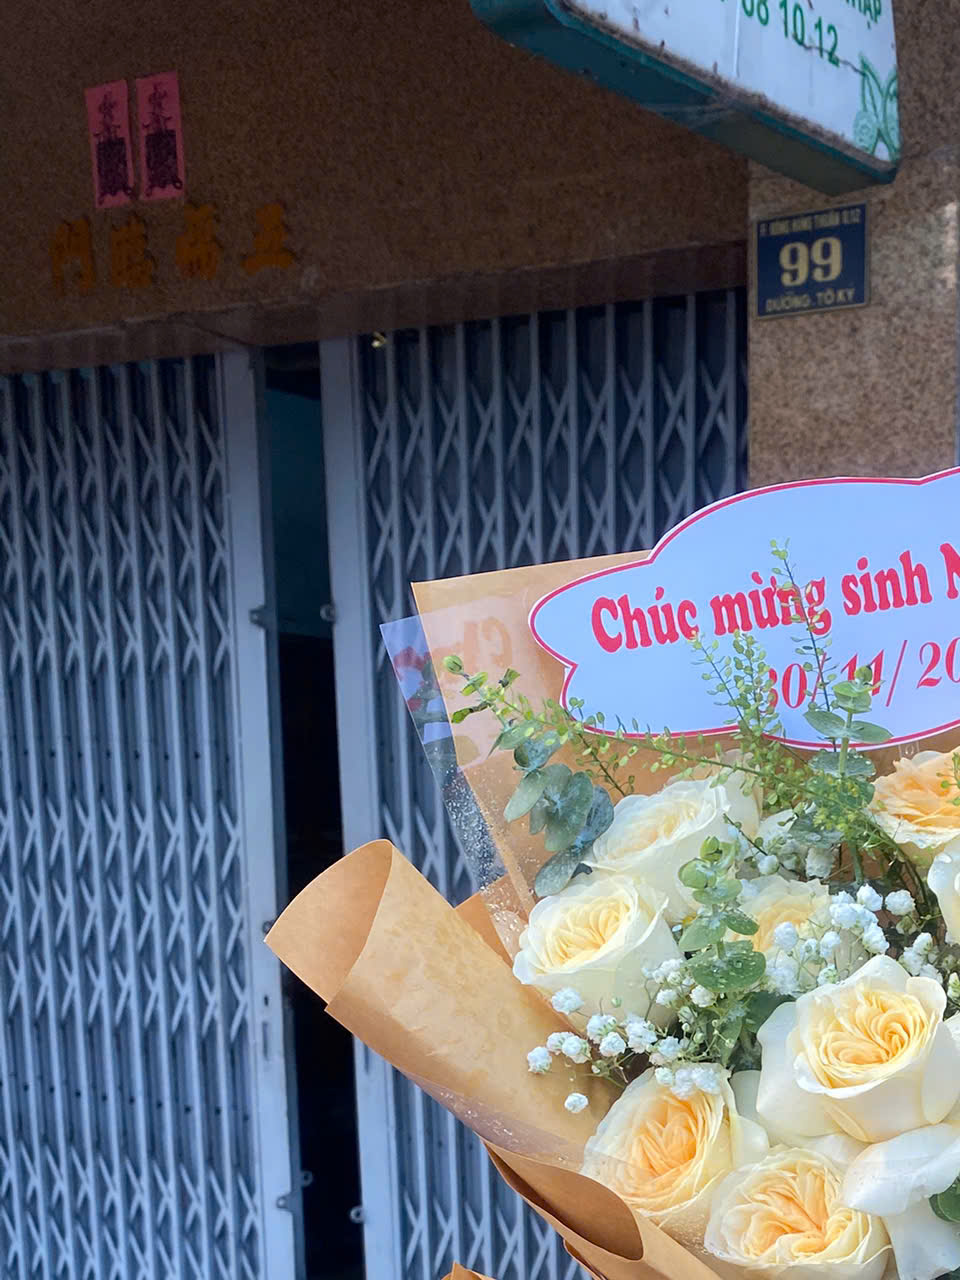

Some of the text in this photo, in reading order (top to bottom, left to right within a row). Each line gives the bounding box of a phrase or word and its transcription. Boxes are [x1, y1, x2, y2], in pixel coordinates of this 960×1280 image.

[779, 236, 843, 288] 99
[591, 587, 700, 653] Chúc
[709, 571, 832, 636] mừng
[841, 550, 932, 616] sinh
